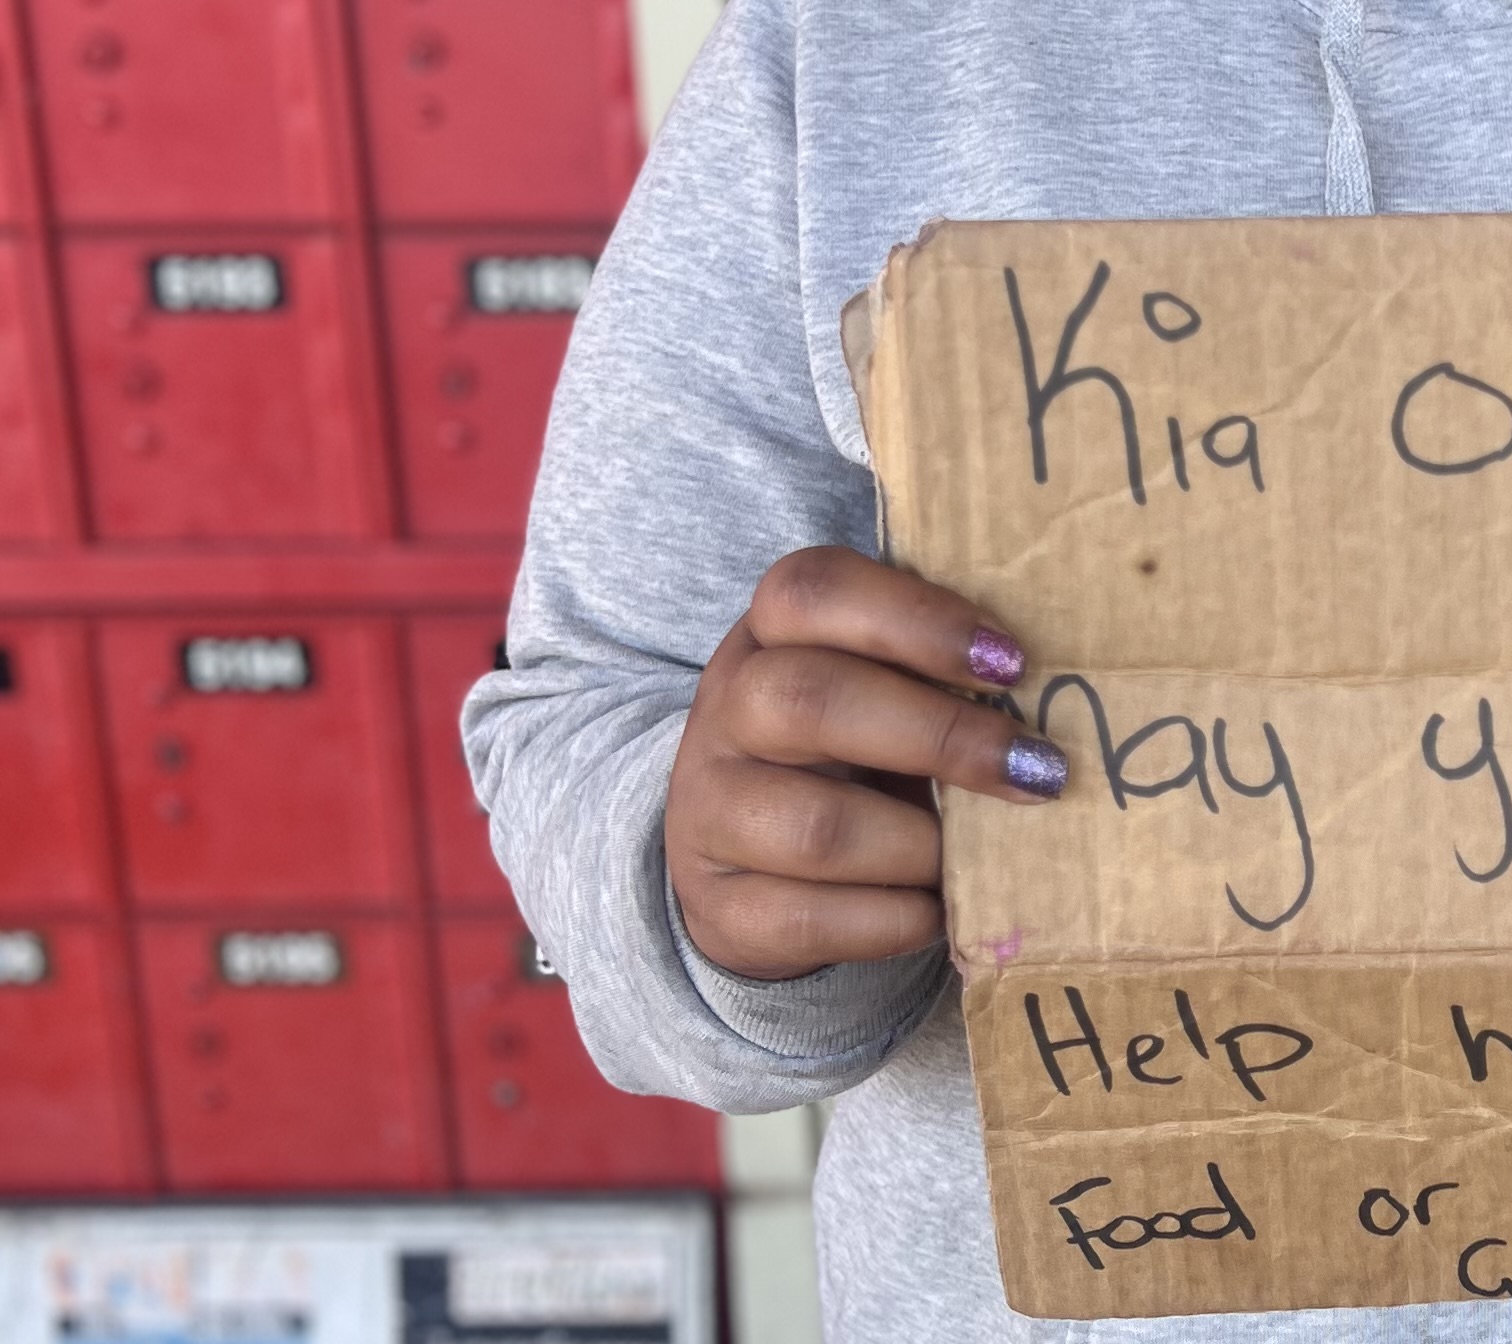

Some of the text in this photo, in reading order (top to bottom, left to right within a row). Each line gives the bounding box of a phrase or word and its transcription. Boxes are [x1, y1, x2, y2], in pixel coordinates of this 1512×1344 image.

[1004, 260, 1265, 506] Kia
[990, 672, 1315, 932] May
[1023, 984, 1314, 1102] Help
[1048, 1160, 1257, 1272] Food
[1357, 1181, 1460, 1238] or
